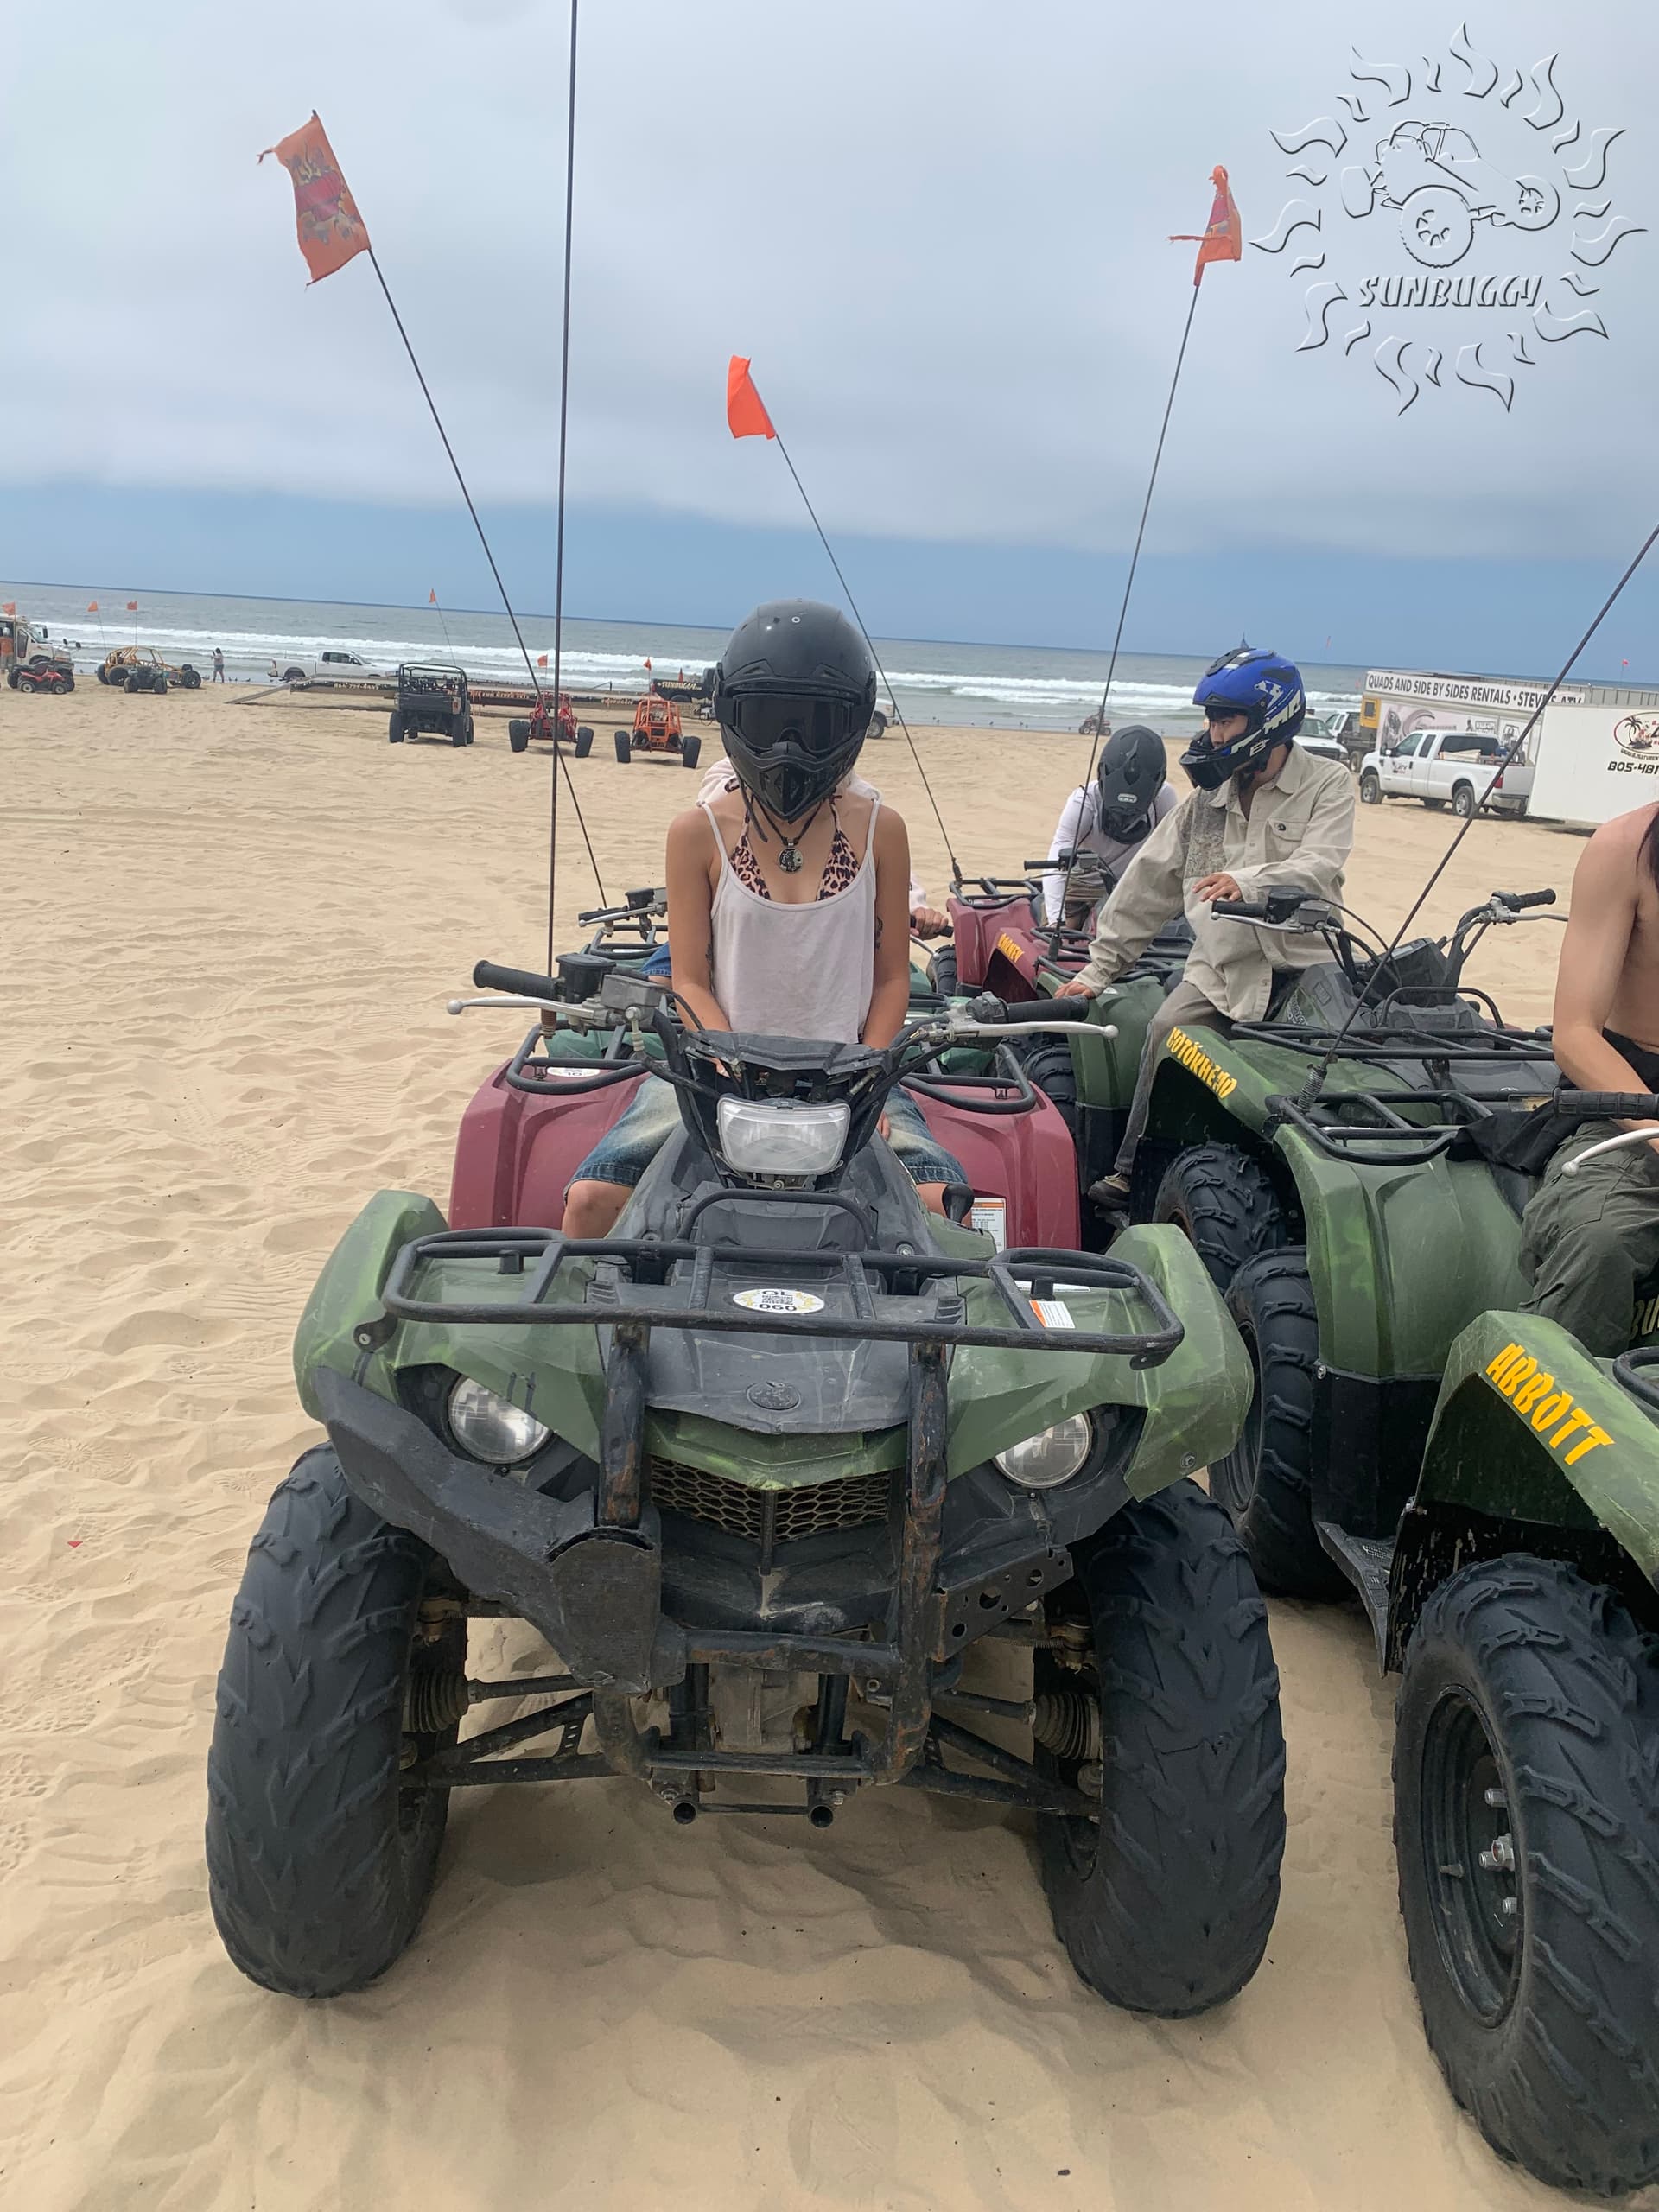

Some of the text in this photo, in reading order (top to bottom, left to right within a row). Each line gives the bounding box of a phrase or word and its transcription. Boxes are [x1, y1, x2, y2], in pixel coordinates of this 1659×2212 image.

[1368, 675, 1394, 690] QUADS
[1395, 679, 1412, 693] AND
[1413, 682, 1432, 696] SIDE
[1433, 683, 1444, 697] BY
[1445, 685, 1470, 701] SIDES
[1471, 688, 1510, 706] RENTALS
[1485, 1342, 1616, 1466] ABBOTT
